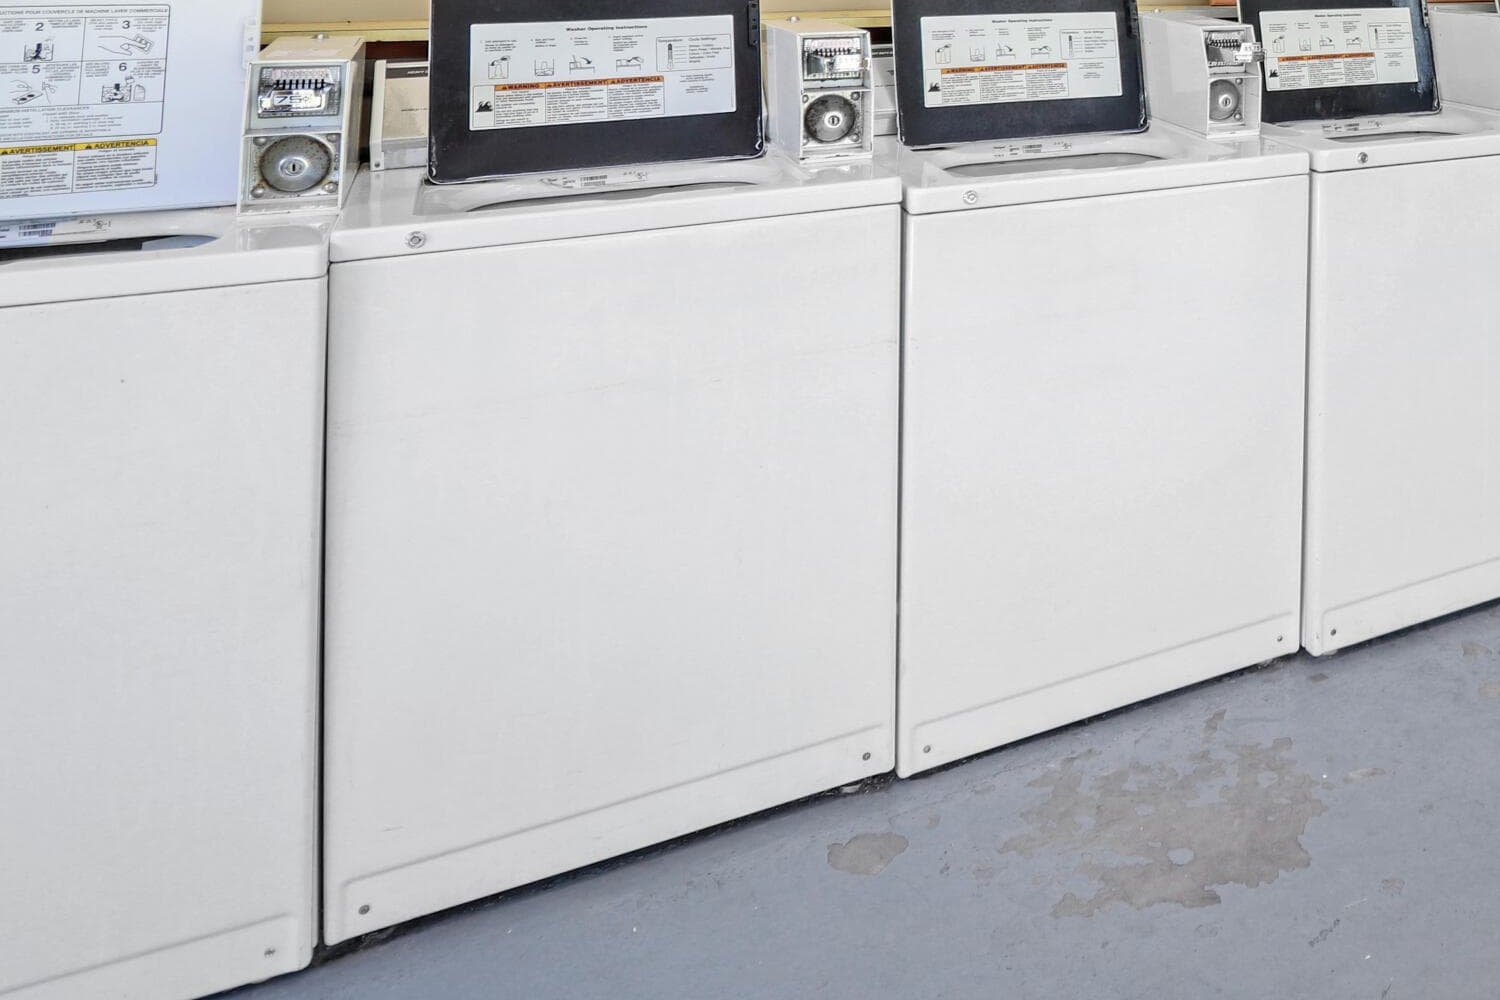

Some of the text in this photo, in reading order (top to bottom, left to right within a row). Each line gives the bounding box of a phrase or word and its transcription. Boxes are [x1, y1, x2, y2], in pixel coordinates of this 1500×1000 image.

[35, 22, 44, 32] 2
[122, 20, 130, 29] 3
[32, 65, 41, 74] 5
[118, 62, 127, 71] 6
[553, 79, 607, 88] AVERTISSEMENT
[617, 76, 661, 84] ADVERTENCIA
[10, 140, 150, 155] AVERTISSEMENT ADVERTENCIA
